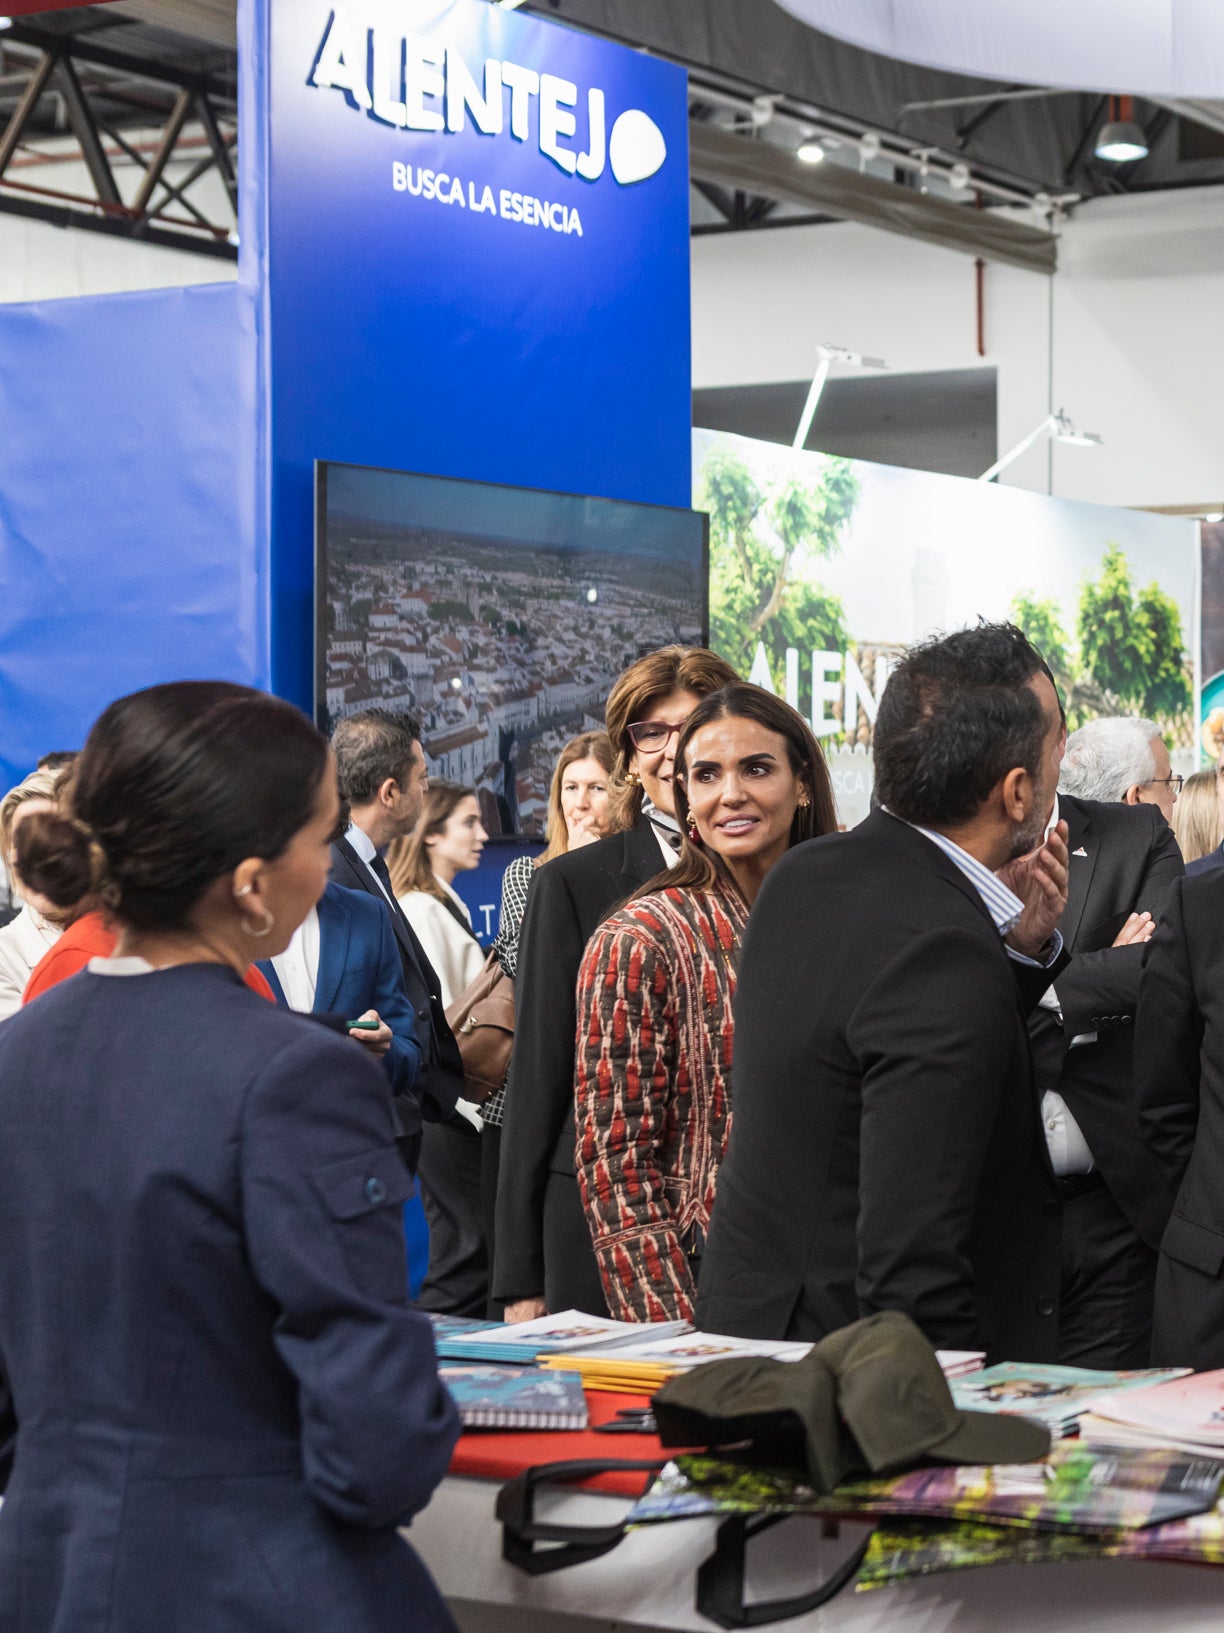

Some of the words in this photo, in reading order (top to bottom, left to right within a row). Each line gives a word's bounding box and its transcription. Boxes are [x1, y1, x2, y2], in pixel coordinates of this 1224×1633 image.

[392, 161, 465, 208] BUSCA
[469, 181, 497, 216] LA
[499, 189, 583, 237] ESENCIA
[750, 641, 900, 738] ALEN
[831, 770, 865, 795] SCA
